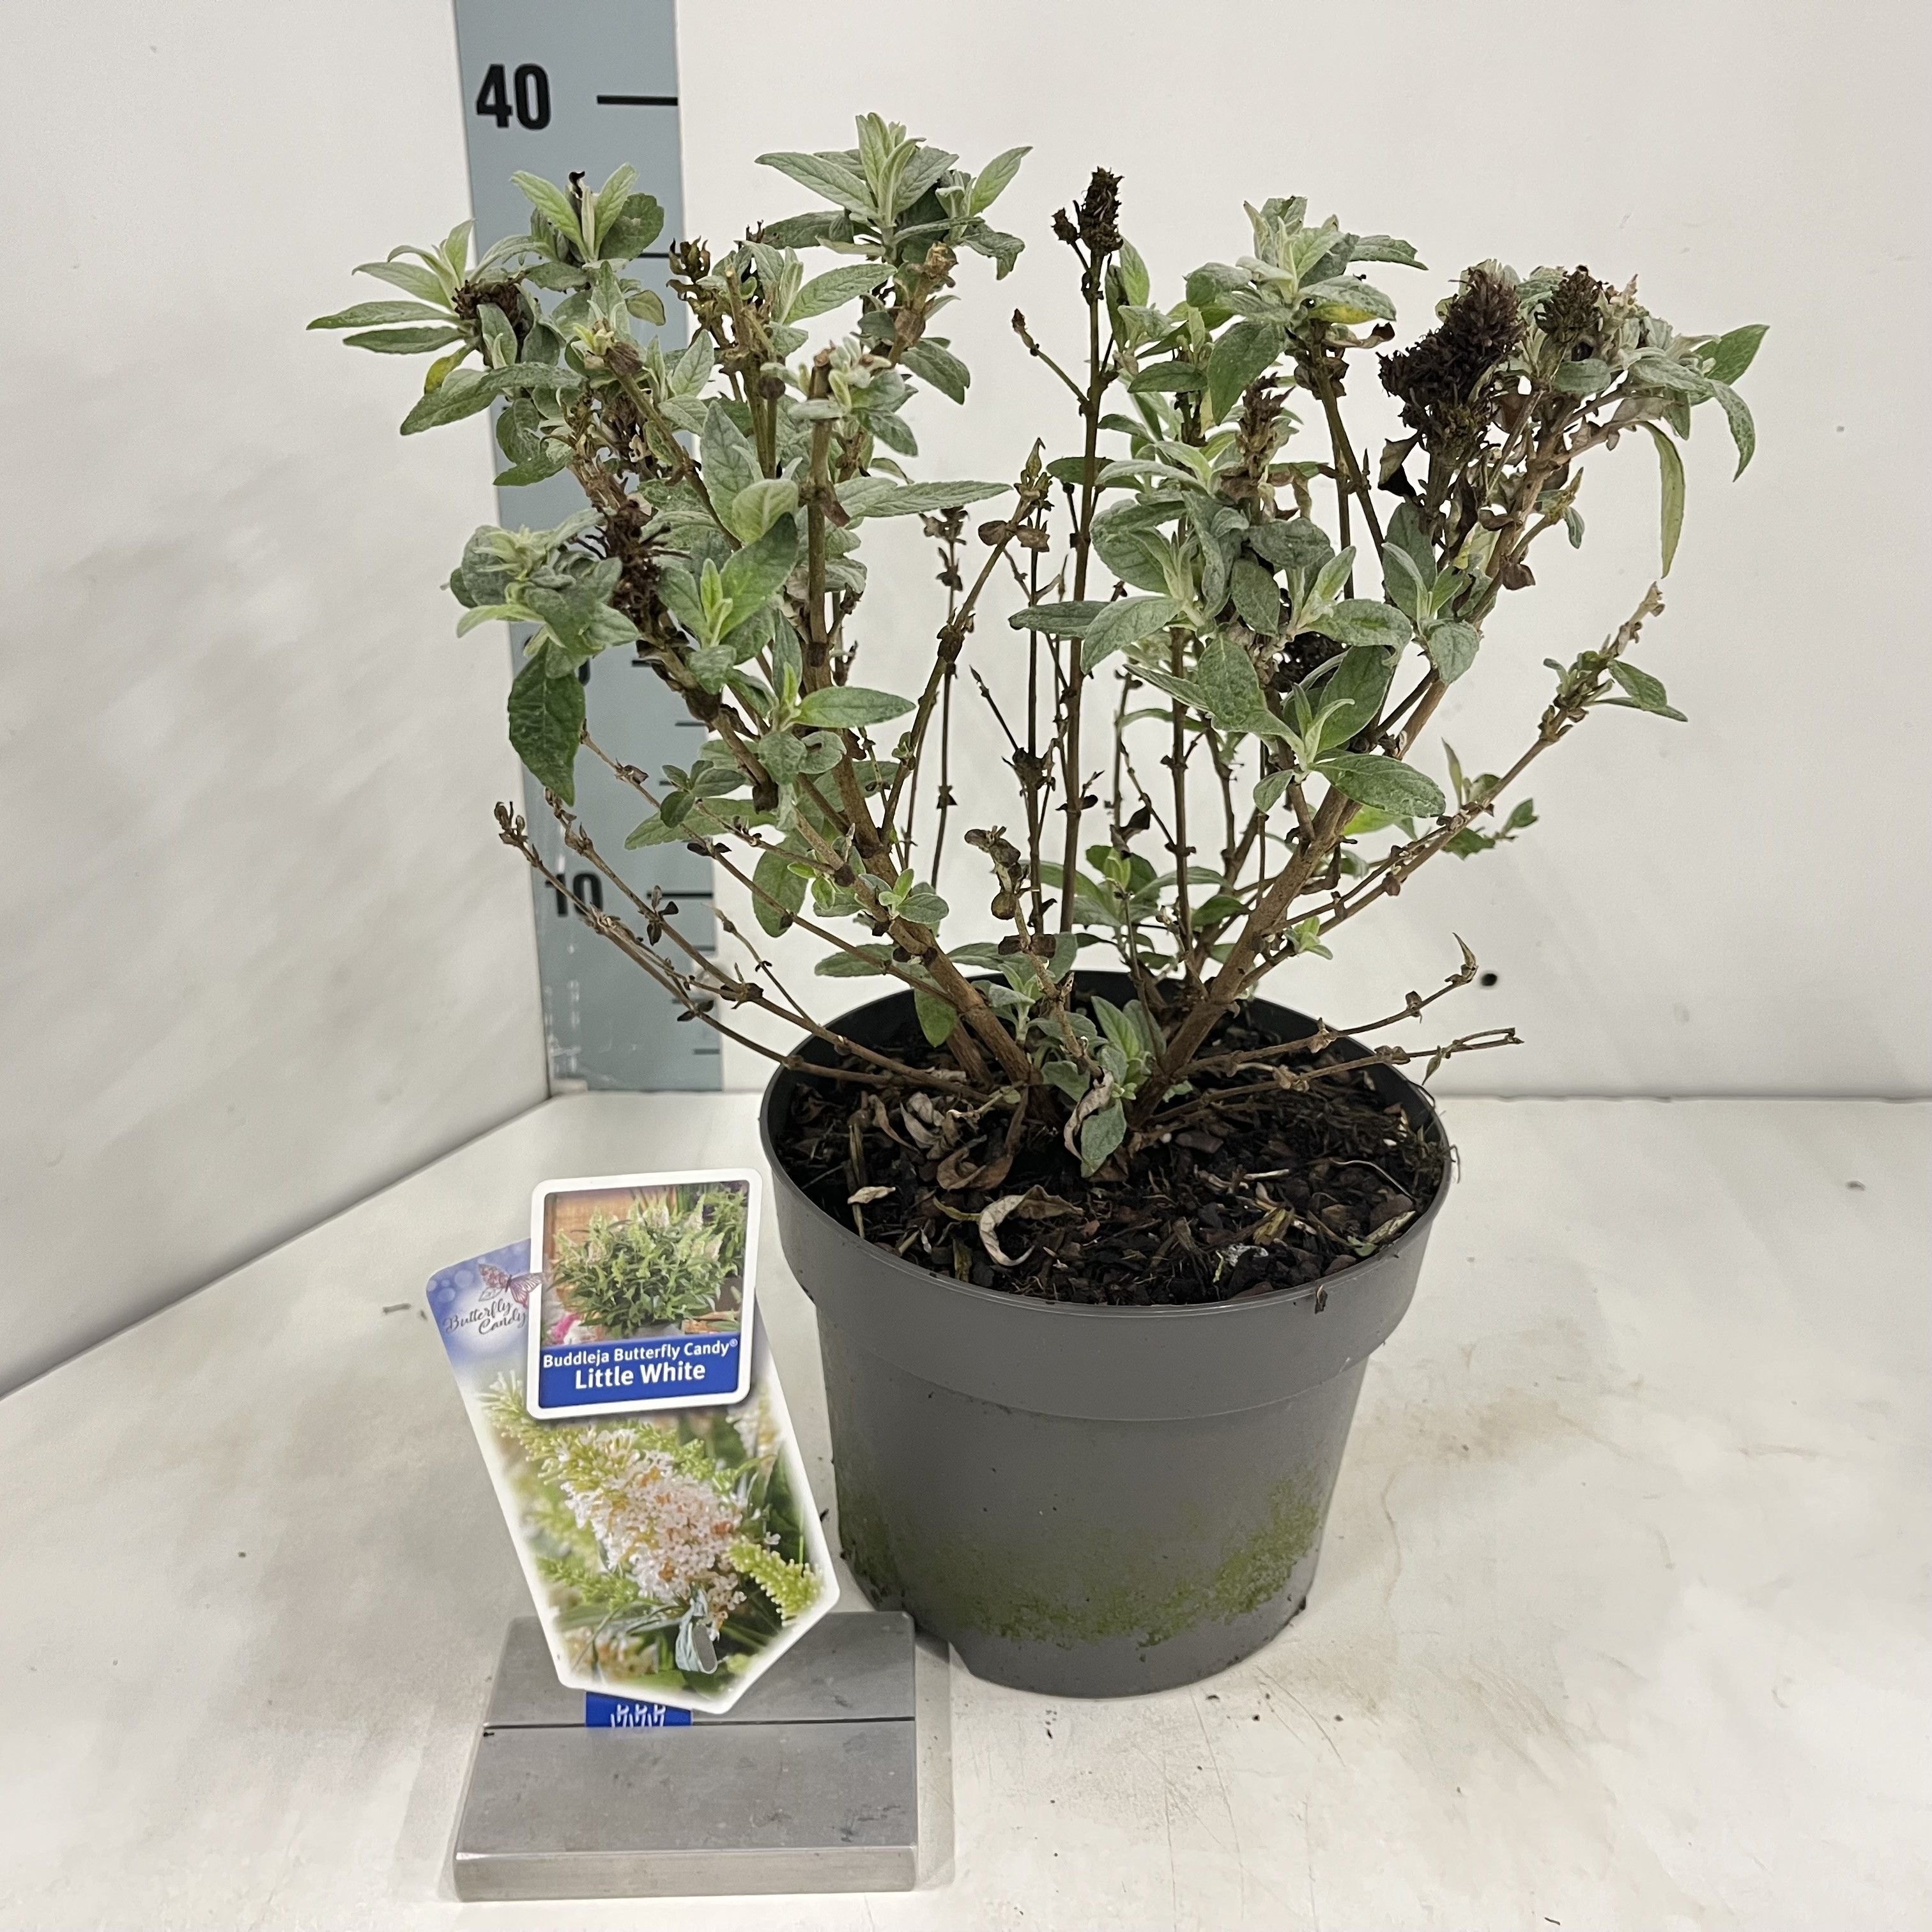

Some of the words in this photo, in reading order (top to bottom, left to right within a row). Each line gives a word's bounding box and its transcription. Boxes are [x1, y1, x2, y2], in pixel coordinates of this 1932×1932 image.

[476, 63, 552, 130] 40
[544, 872, 604, 919] 10
[443, 1298, 512, 1333] Butterfly
[479, 1308, 526, 1335] Candy
[543, 1349, 610, 1368] Buddleja
[614, 1344, 681, 1361] Butterfly
[575, 1365, 634, 1390] Little
[640, 1360, 707, 1384] White
